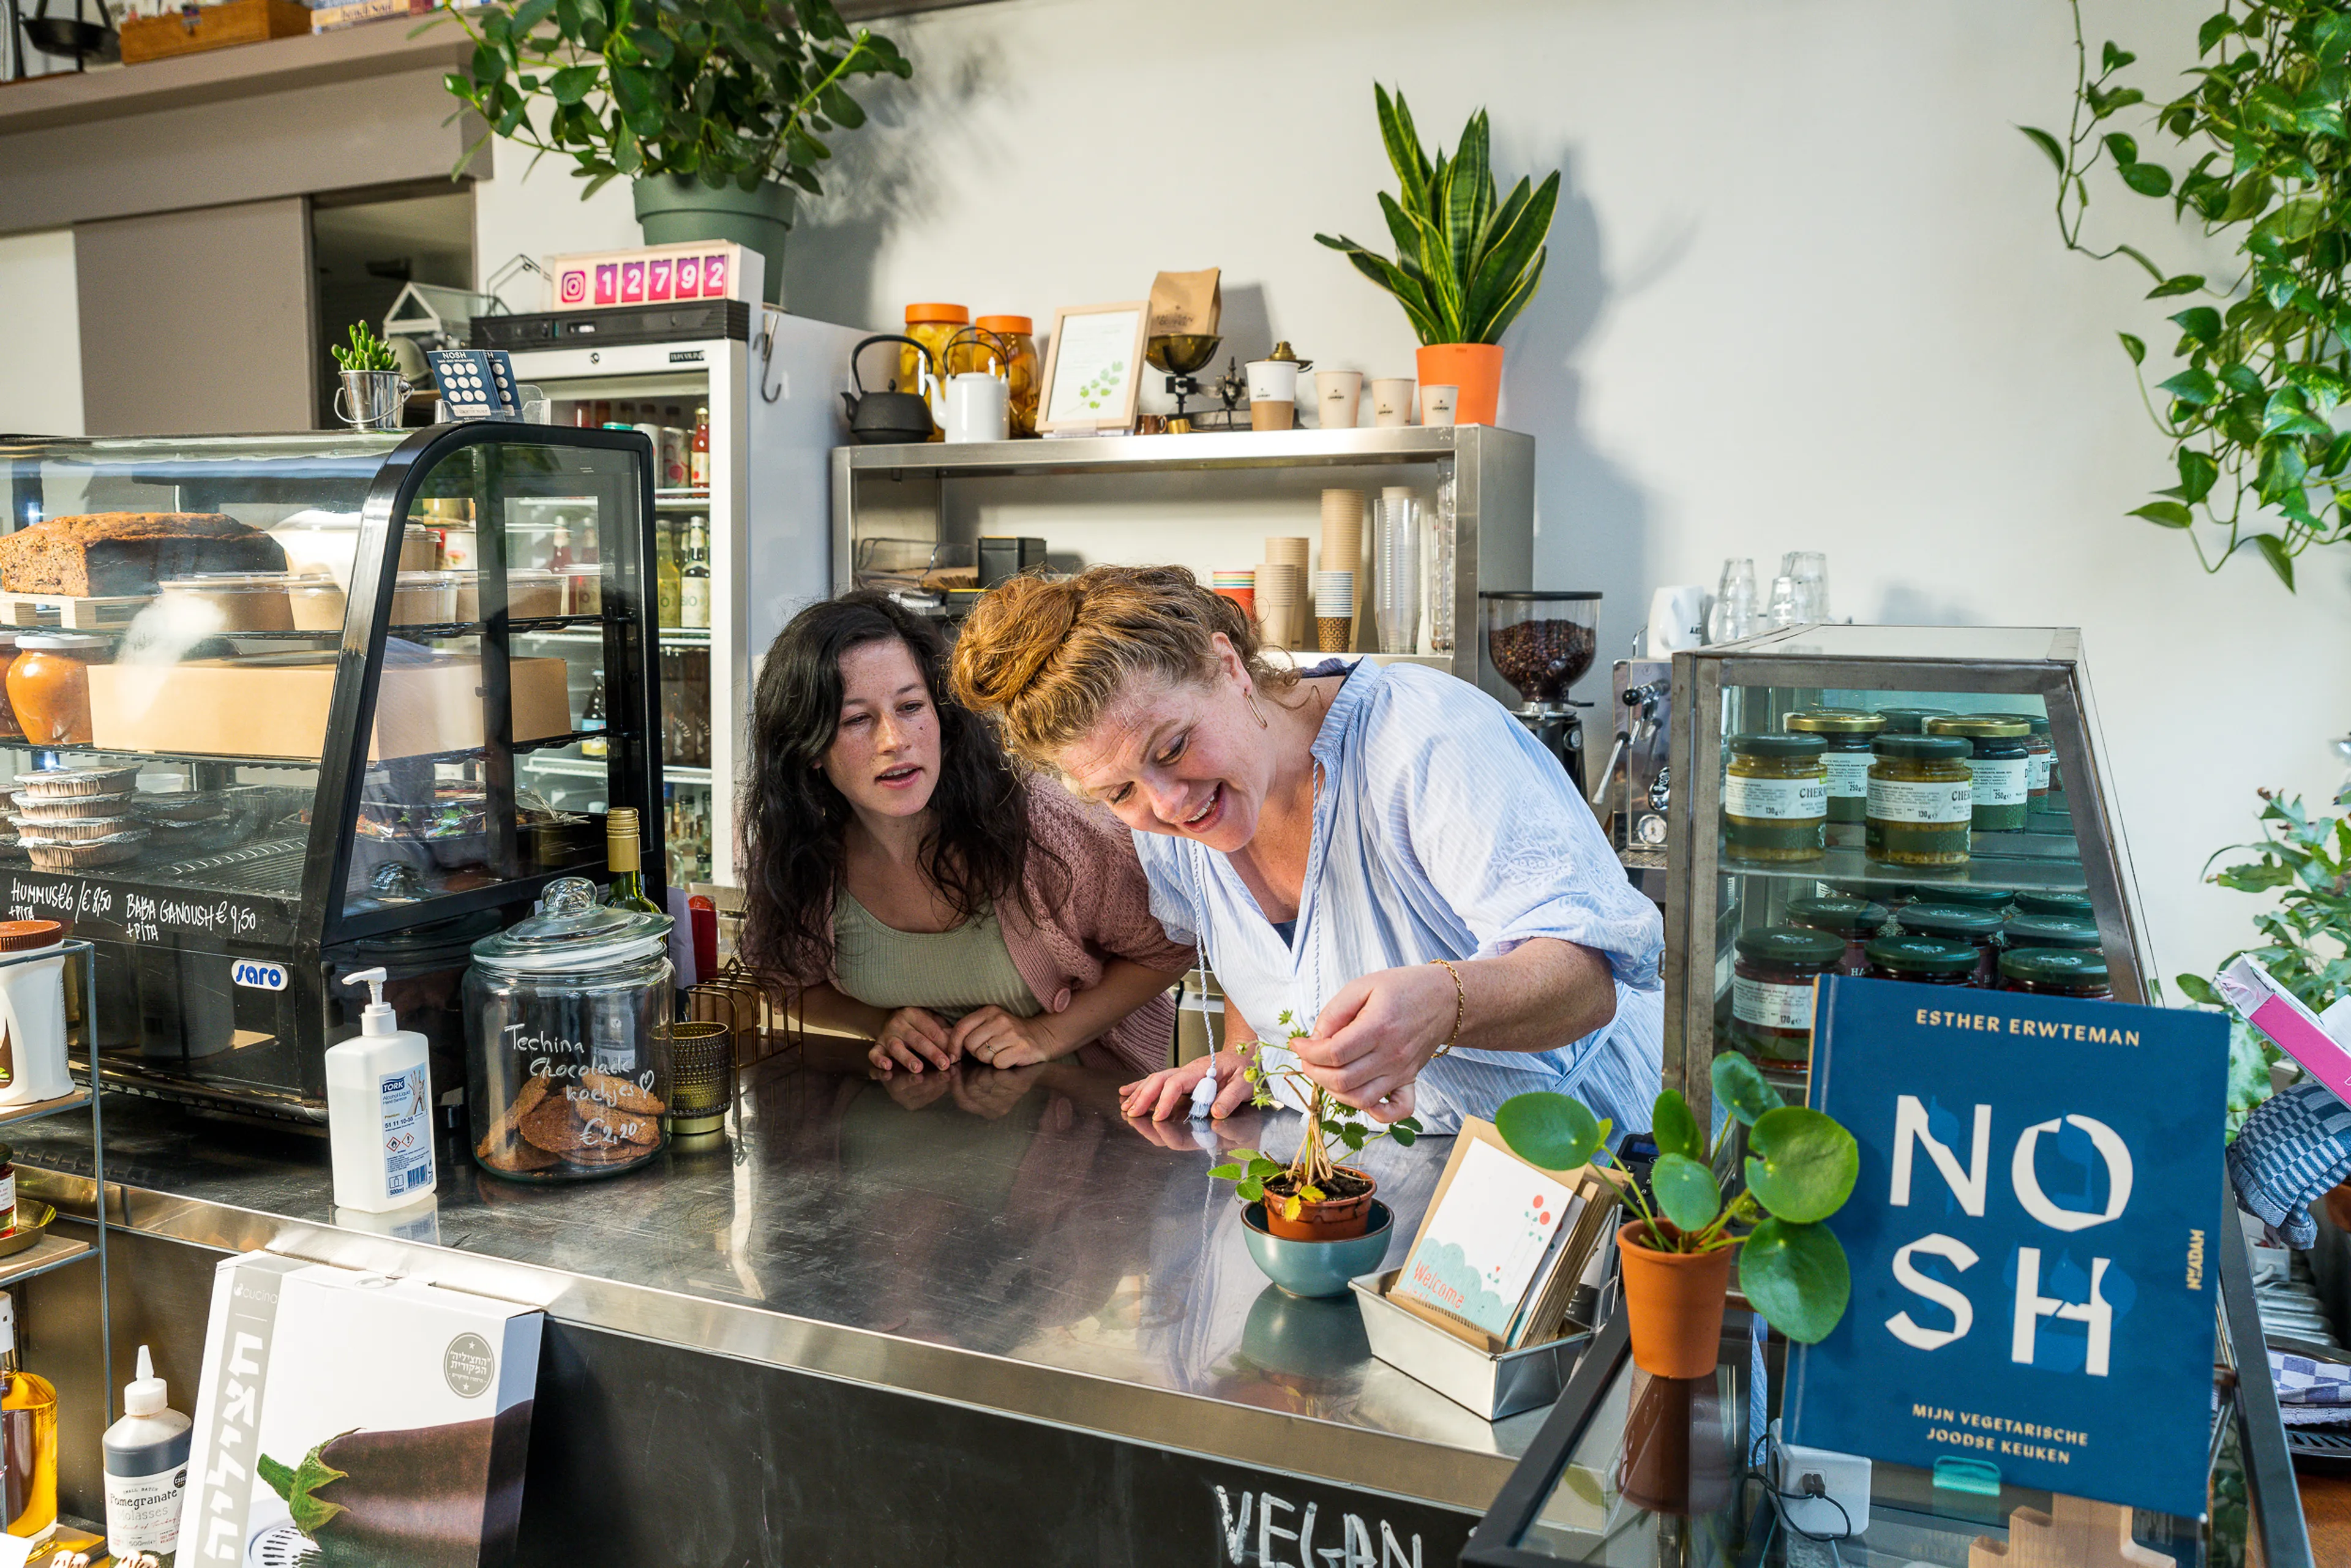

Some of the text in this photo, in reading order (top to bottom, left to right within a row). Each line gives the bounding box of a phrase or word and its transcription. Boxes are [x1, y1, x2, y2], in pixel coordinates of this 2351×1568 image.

[601, 261, 724, 296] 12792
[126, 893, 156, 920] BABA
[160, 899, 214, 931] GANOUSH
[236, 964, 281, 987] saro
[504, 1023, 585, 1053] Techina
[1916, 1008, 2140, 1047] ESTHER ERWTEMAN
[530, 1054, 629, 1079] Chocolade
[383, 1081, 403, 1092] TORK
[1890, 1094, 2134, 1232] NO
[1414, 1259, 1464, 1309] Welcome
[1884, 1232, 2112, 1377] SH
[1913, 1403, 2088, 1447] MIJN VEGETARISCHE
[1927, 1428, 2070, 1465] JOODSE KEUKEN
[110, 1489, 178, 1510] Pomegranate
[116, 1506, 168, 1521] Molasses
[1214, 1485, 1423, 1568] VEGAN
